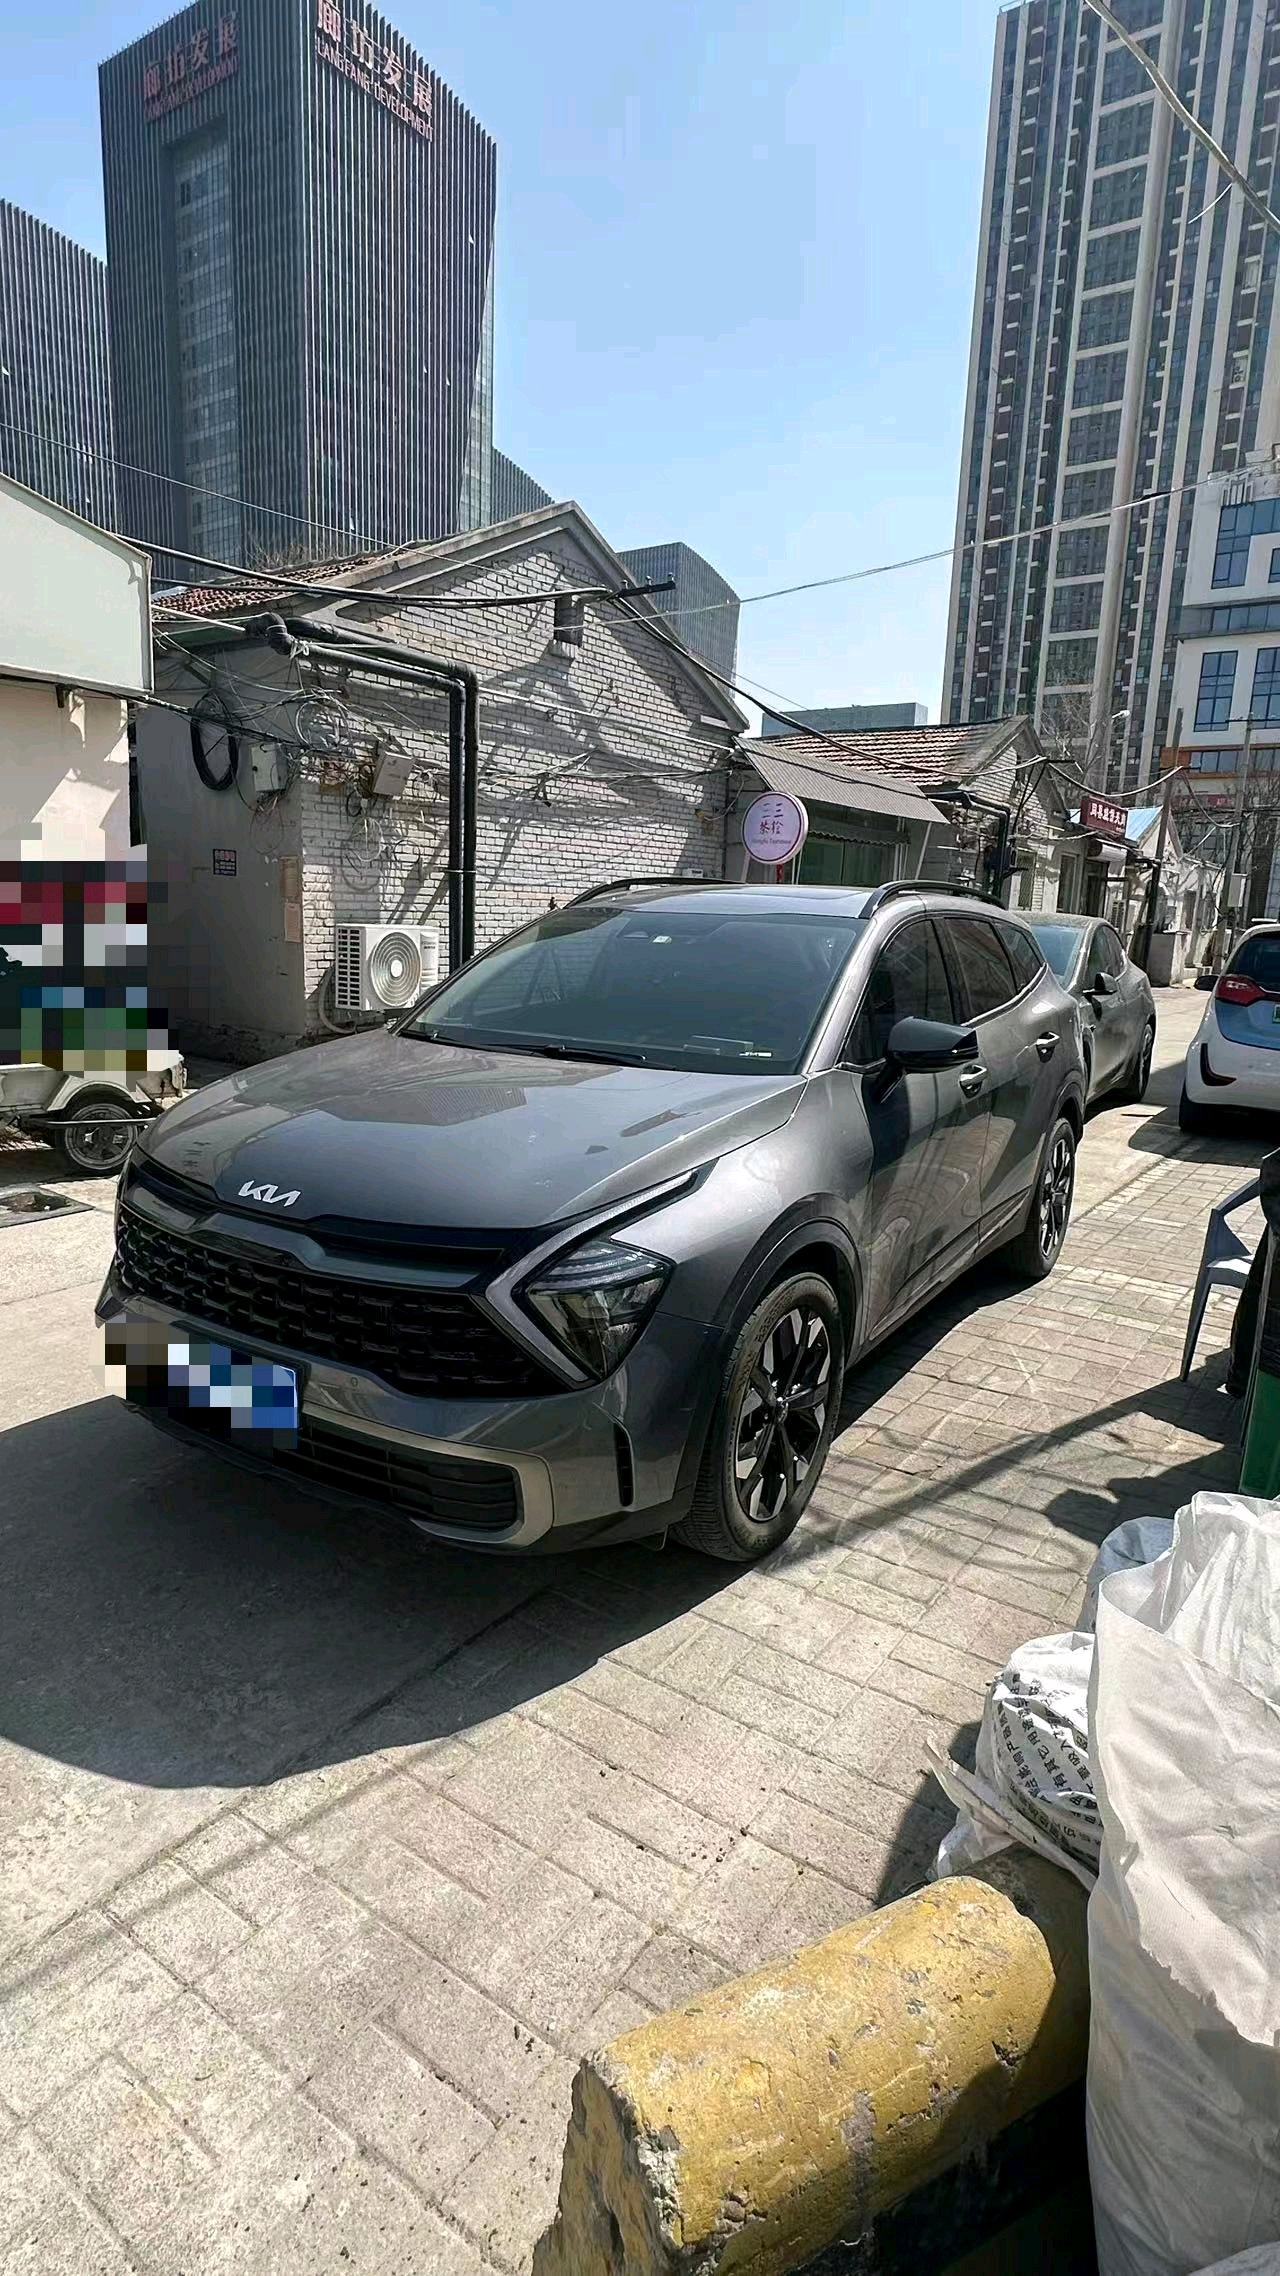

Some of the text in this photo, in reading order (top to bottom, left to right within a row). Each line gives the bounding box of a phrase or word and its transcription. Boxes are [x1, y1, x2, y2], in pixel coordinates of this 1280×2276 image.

[317, 0, 433, 117] 廊坊发展
[374, 84, 434, 142] DEVELOPMENT
